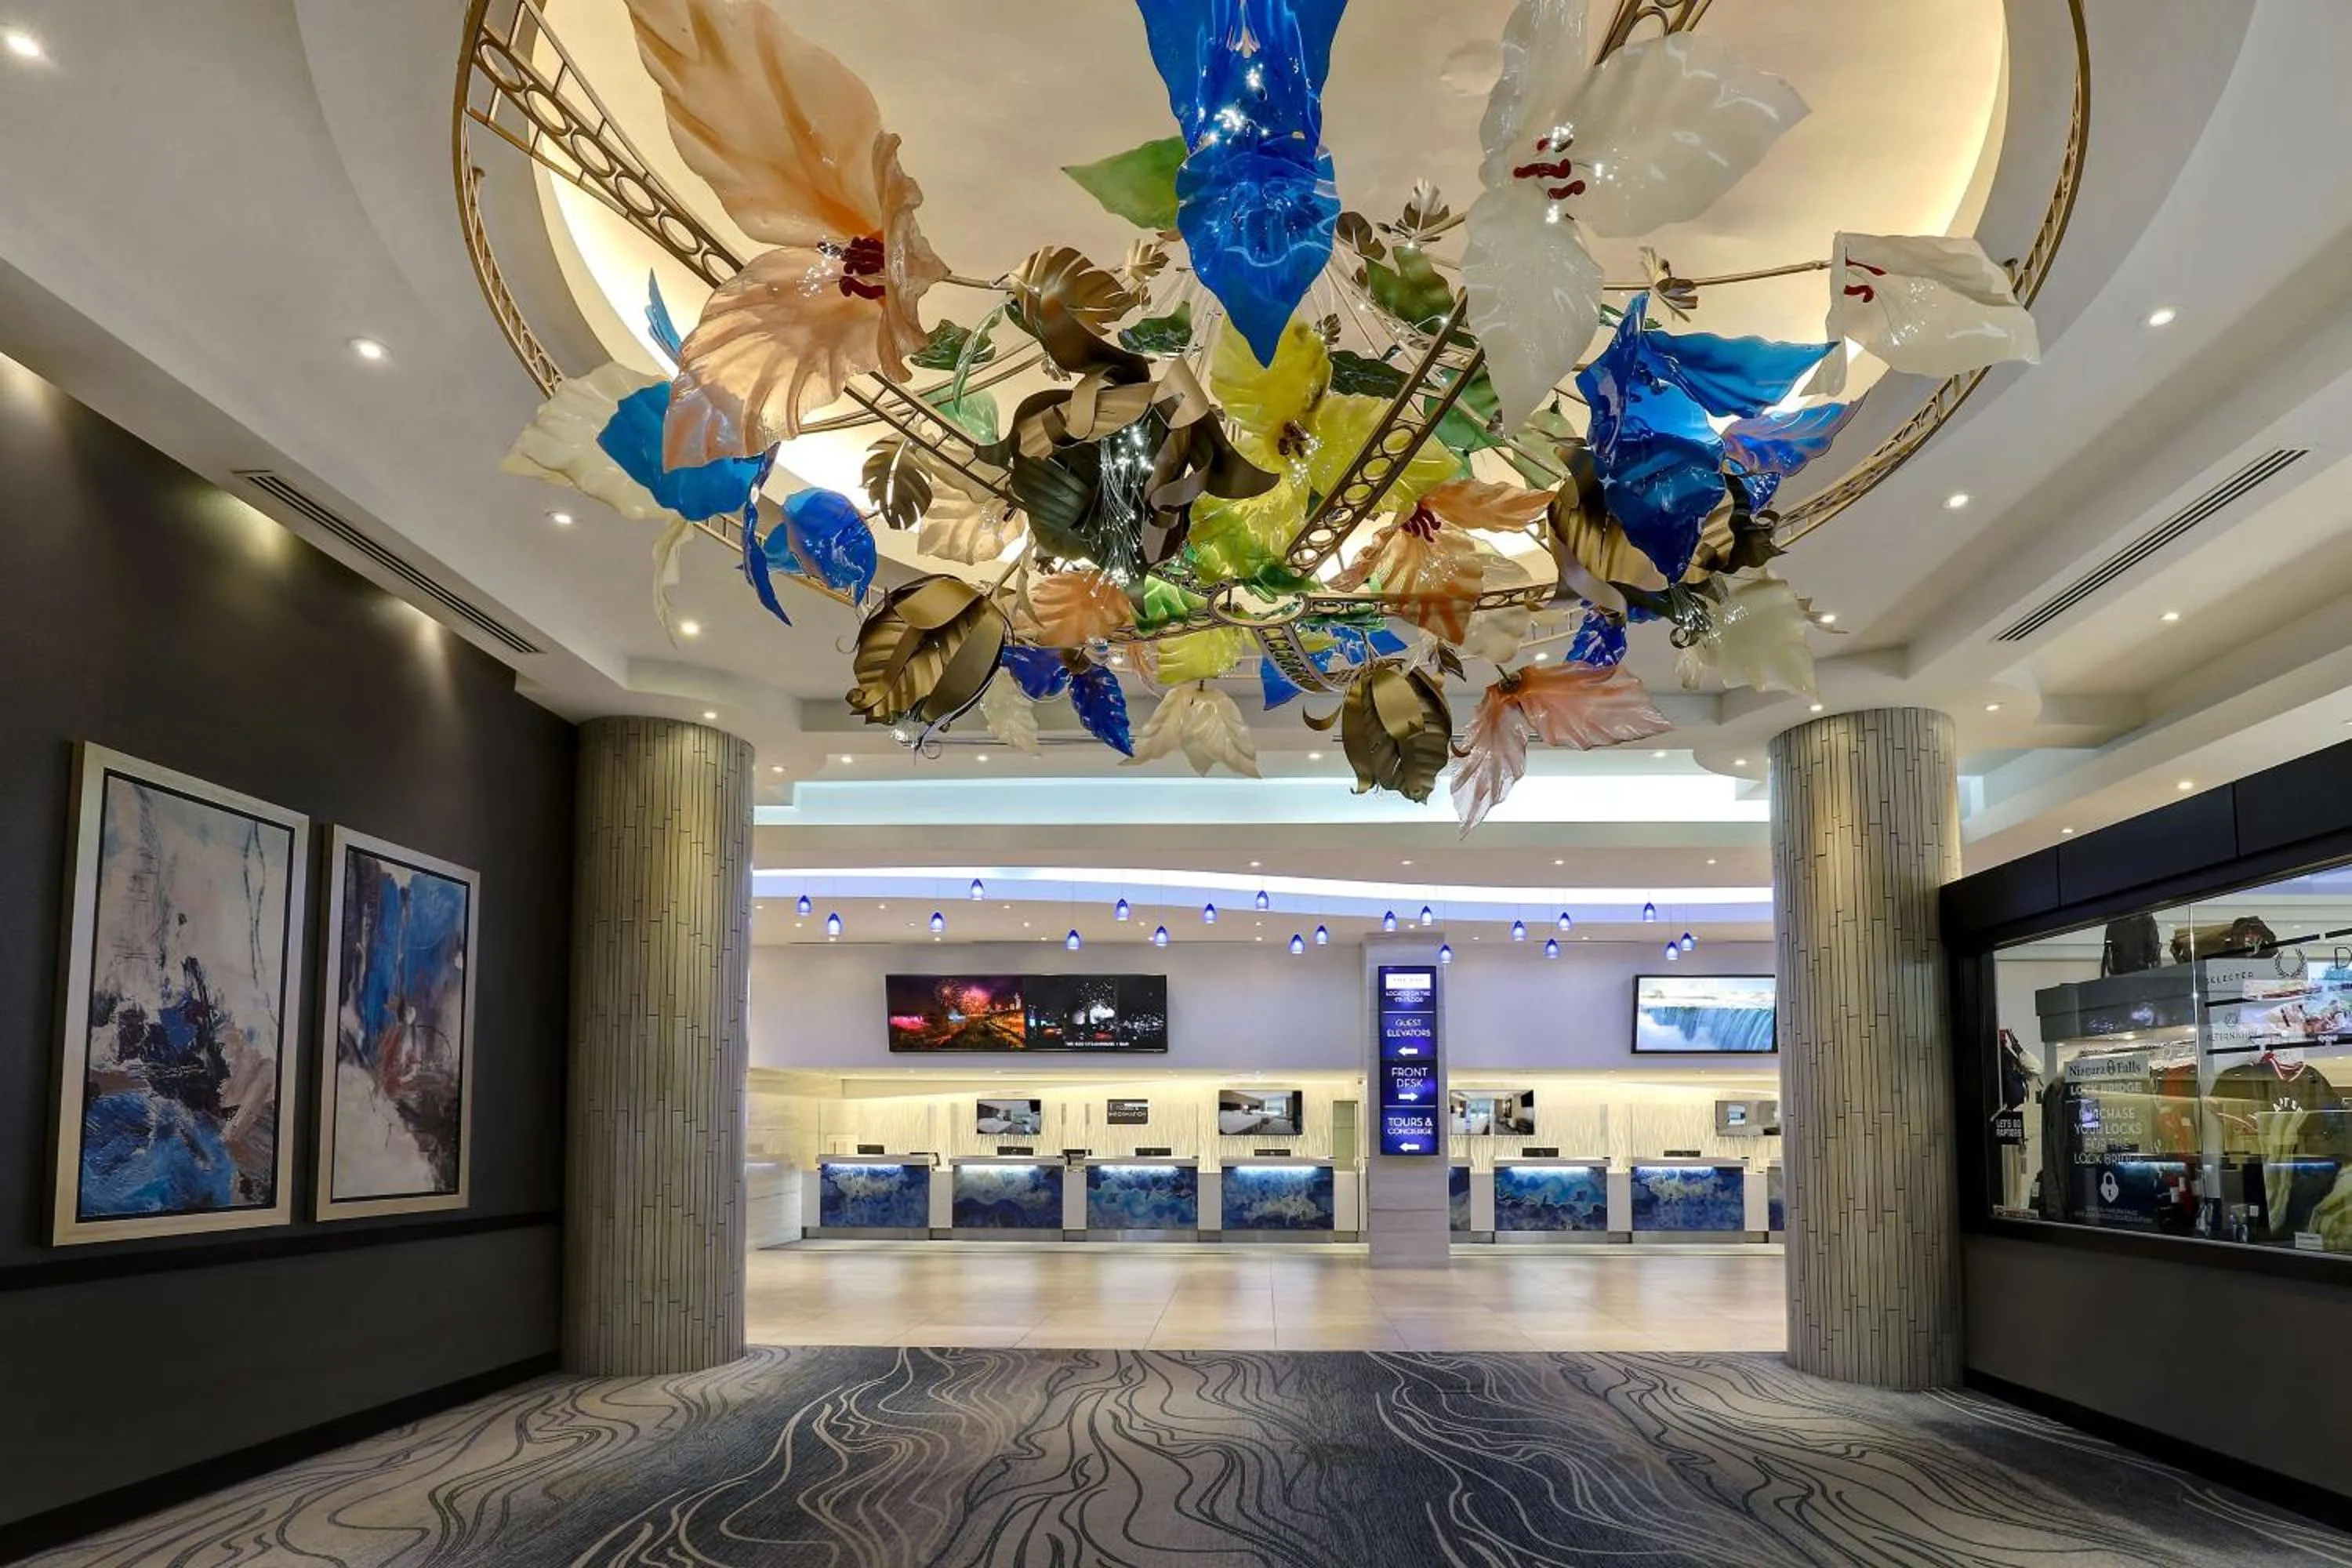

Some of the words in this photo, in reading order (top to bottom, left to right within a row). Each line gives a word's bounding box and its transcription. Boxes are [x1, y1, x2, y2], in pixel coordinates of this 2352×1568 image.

[1395, 1018, 1422, 1027] GUEST
[1386, 1028, 1432, 1037] ELEVATORS
[1392, 1067, 1428, 1077] FRONT
[2068, 1065, 2106, 1079] Niagara
[2117, 1060, 2142, 1073] Falls
[1396, 1078, 1424, 1088] DESK
[1387, 1117, 1424, 1127] TOURS
[1425, 1117, 1432, 1127] &
[2074, 1121, 2103, 1136] YOUR
[2105, 1121, 2143, 1135] LOCKS
[2073, 1152, 2102, 1165] LOCK
